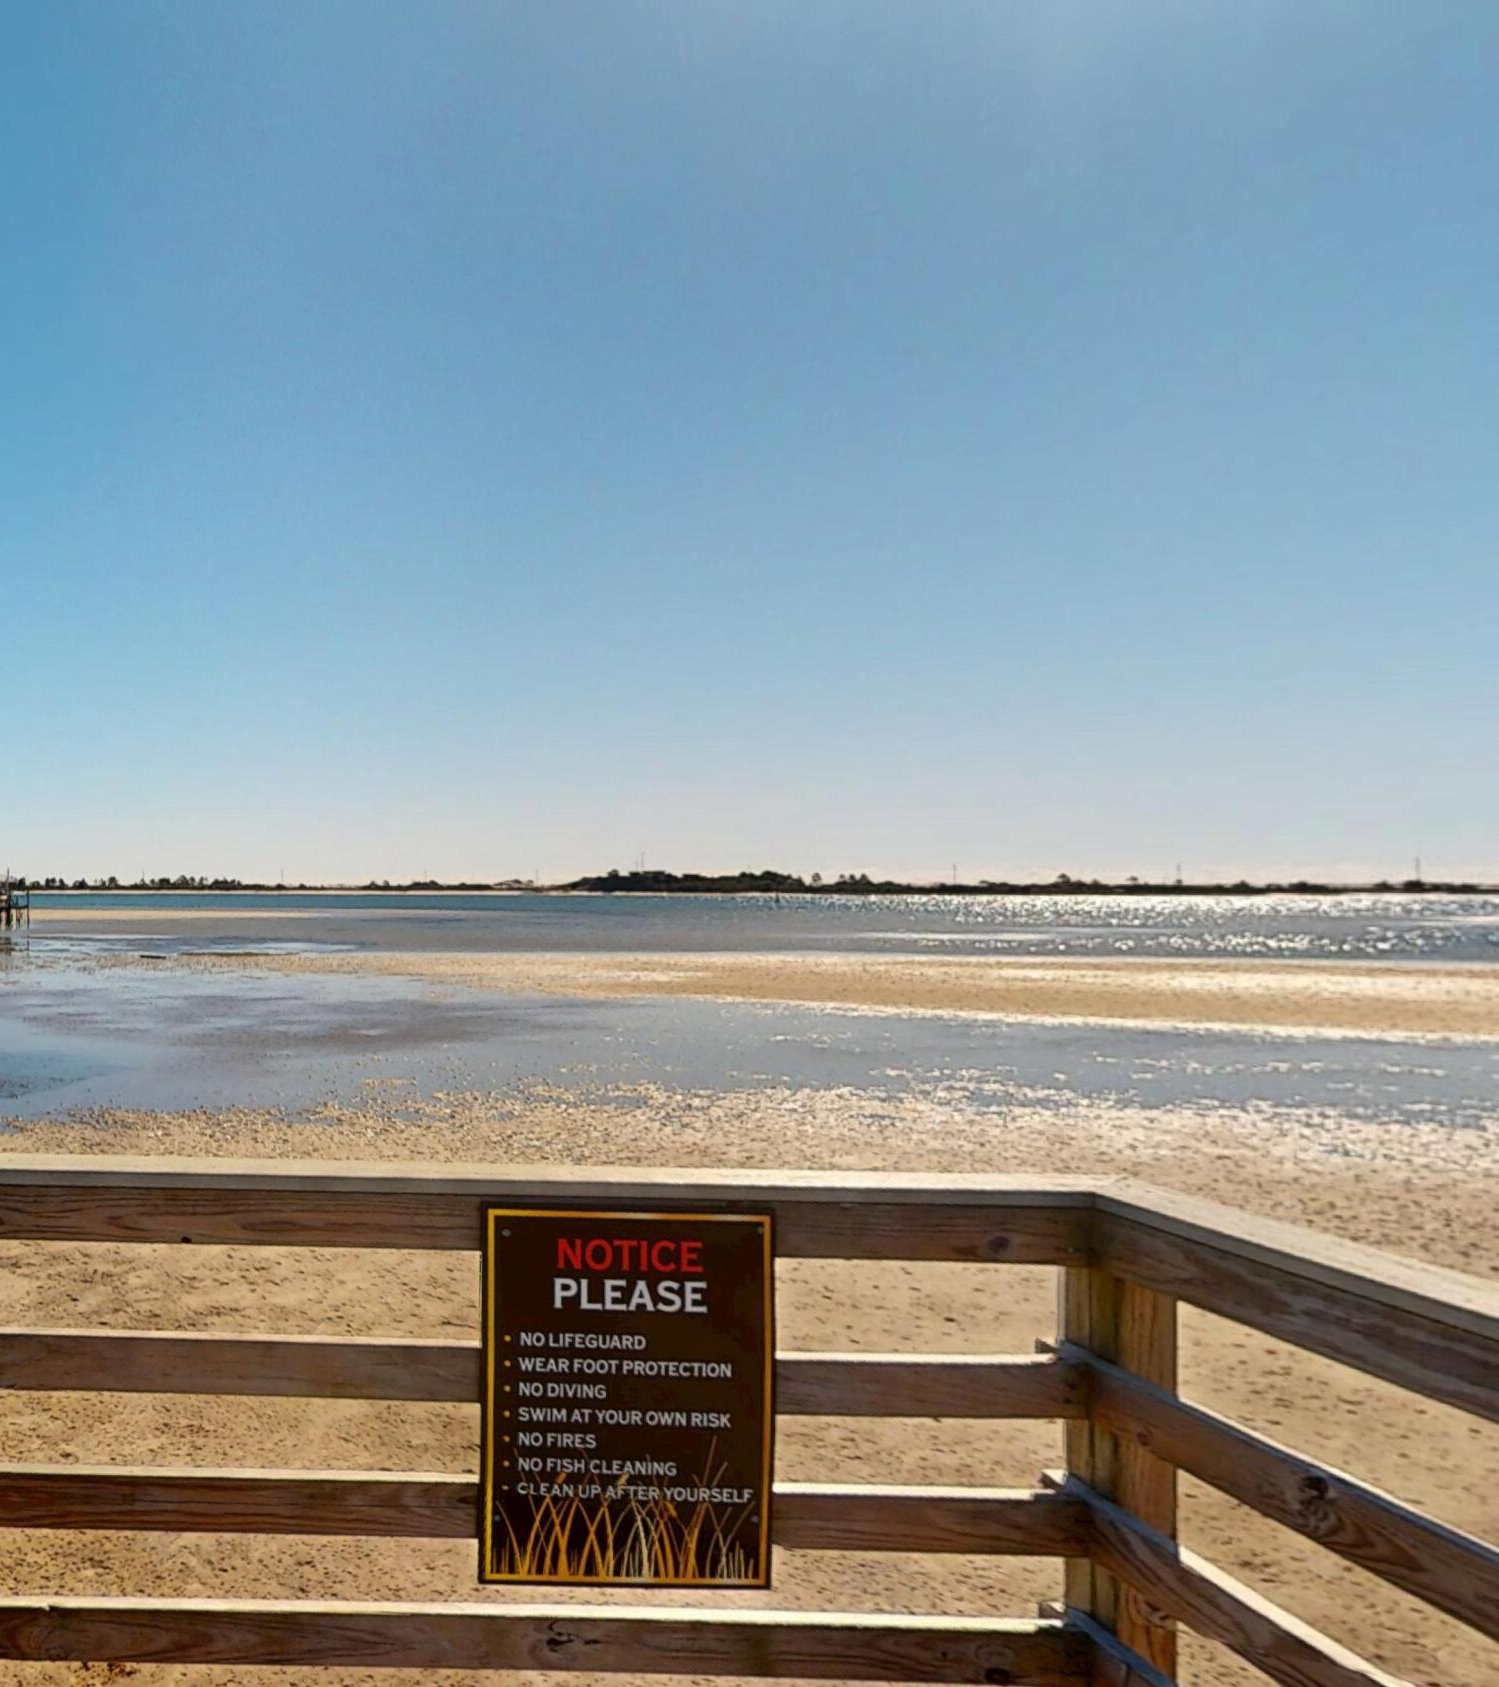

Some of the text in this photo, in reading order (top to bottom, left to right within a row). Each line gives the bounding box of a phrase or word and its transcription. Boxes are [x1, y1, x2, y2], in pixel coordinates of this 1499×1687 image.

[557, 1238, 704, 1272] NOTICE
[553, 1278, 708, 1314] PLEASE
[520, 1332, 646, 1350] NO LIFEGUARD
[519, 1358, 732, 1378] WEAR FOOT PROTECTION
[519, 1383, 607, 1399] NO DIVING
[518, 1407, 731, 1428] SWIM AT YOUR OWN RISK
[518, 1432, 596, 1448] NO FIRES
[518, 1458, 677, 1476] NO FISH CLEANING
[517, 1482, 754, 1503] CLEAN UP AFTER YOURSELF
